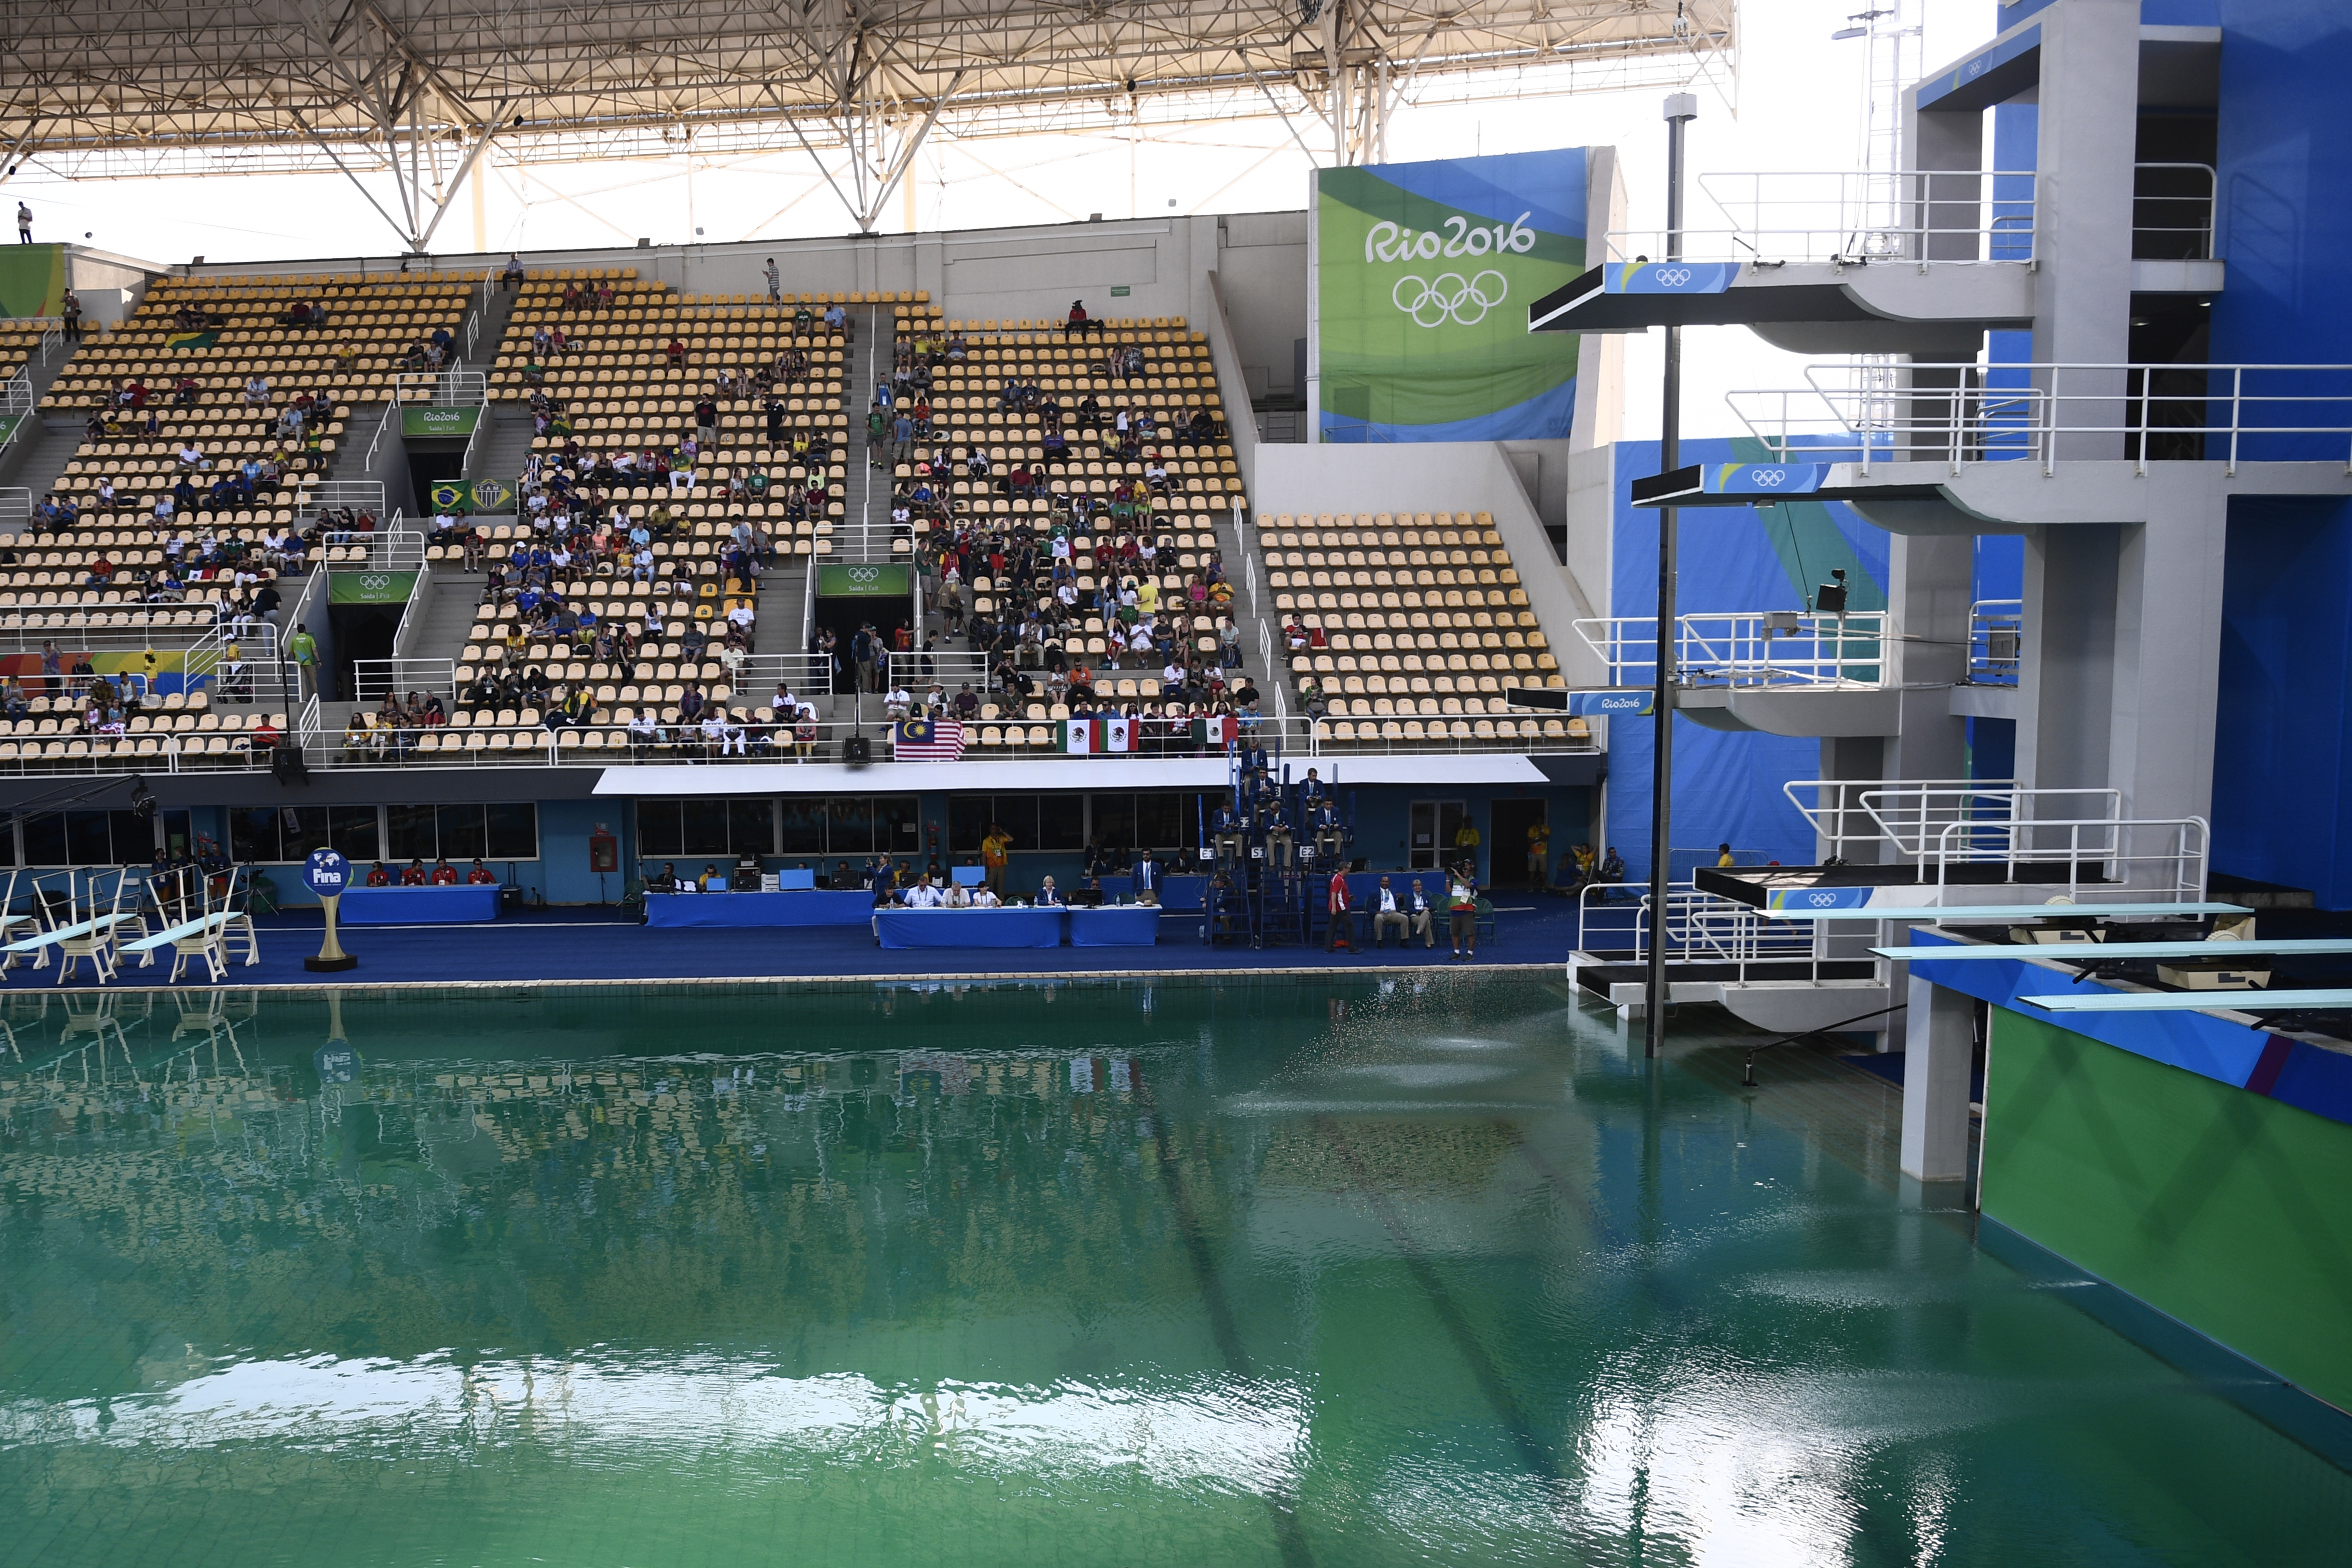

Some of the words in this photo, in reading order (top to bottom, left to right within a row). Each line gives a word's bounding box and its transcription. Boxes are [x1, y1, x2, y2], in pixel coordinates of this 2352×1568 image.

[1202, 849, 1214, 858] E1
[1253, 848, 1264, 857] S1
[1302, 848, 1314, 856] E2
[313, 868, 341, 883] Fina
